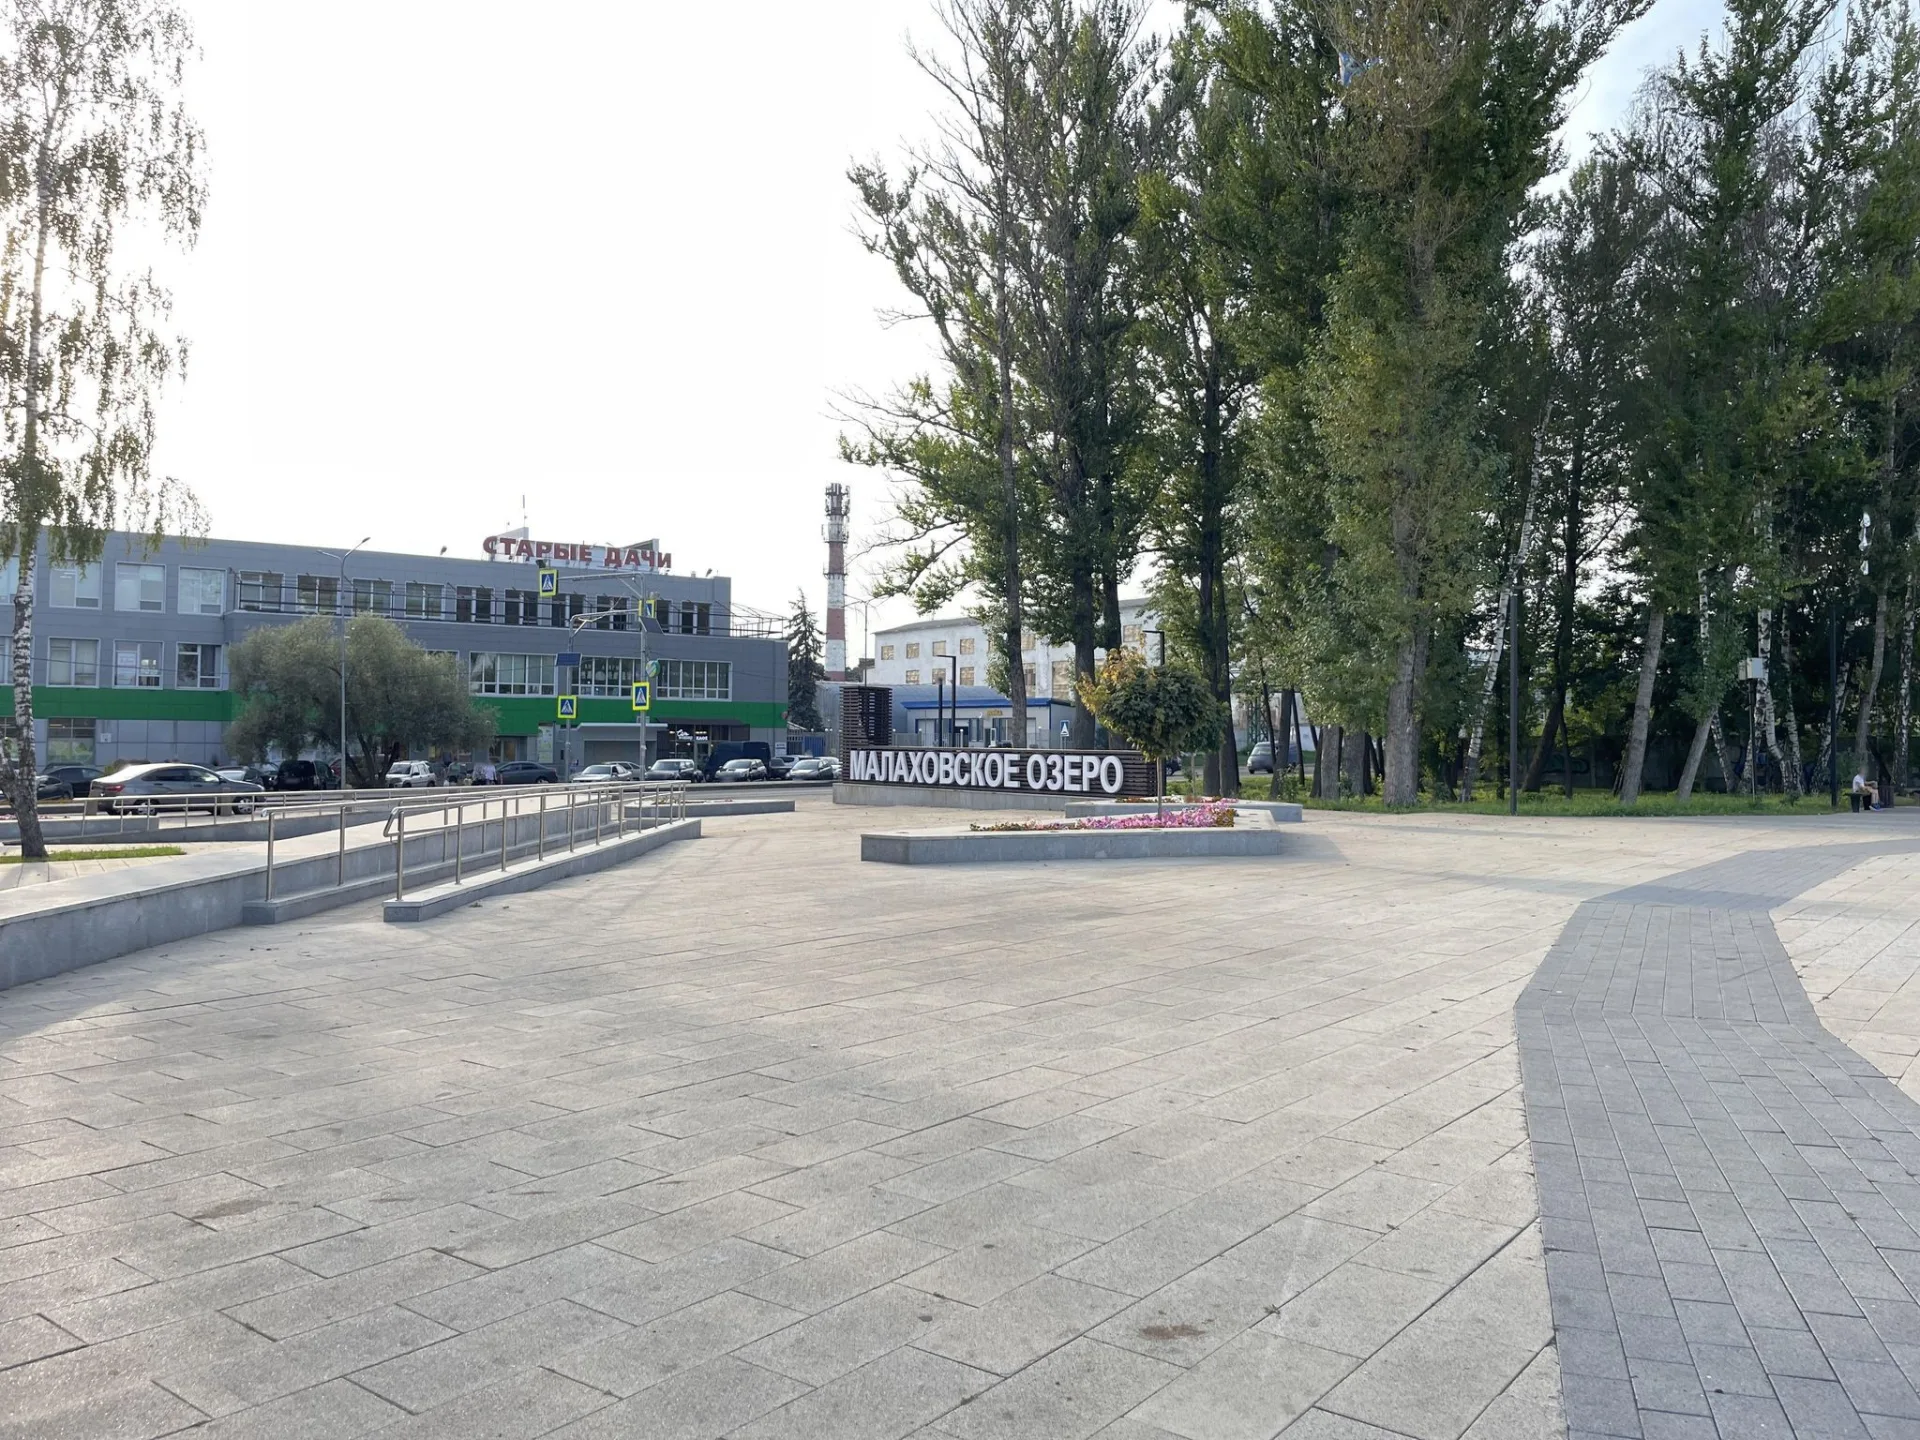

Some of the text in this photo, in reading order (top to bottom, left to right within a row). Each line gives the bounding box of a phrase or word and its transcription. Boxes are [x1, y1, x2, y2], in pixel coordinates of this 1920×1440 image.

[483, 536, 672, 569] СТАРЫЕ ДАЧИ
[850, 750, 1124, 793] МАЛАХОВСКОЕ ОЗЕРО
